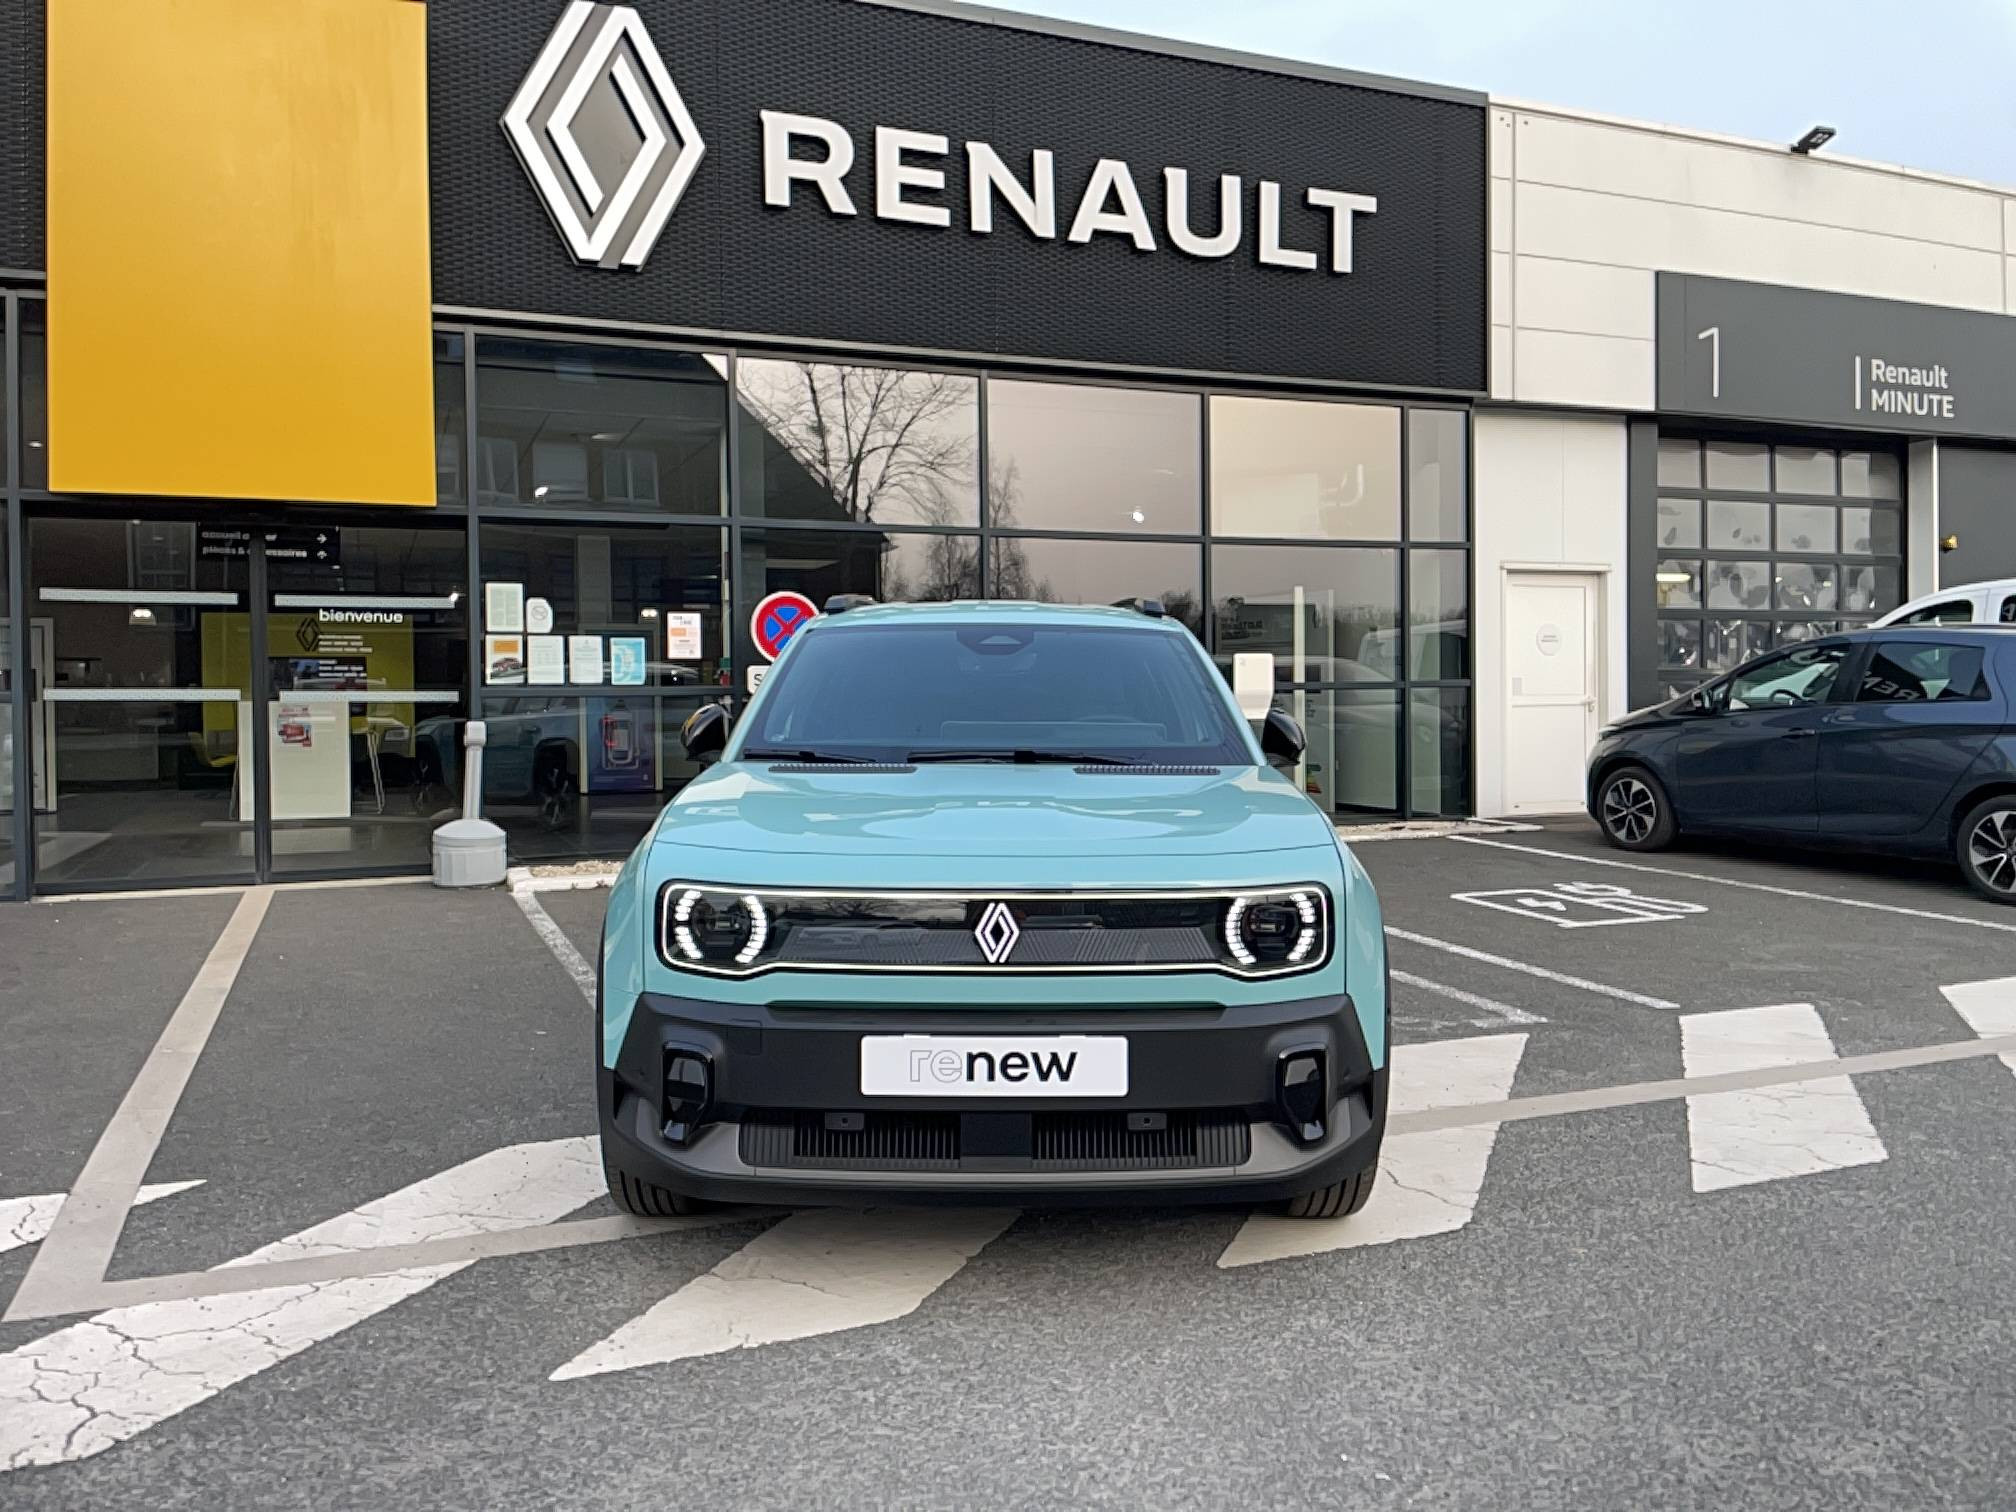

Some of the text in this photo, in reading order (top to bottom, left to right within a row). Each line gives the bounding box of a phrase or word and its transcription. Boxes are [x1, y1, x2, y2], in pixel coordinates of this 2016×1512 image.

[759, 109, 1378, 274] RENAULT
[1698, 327, 1720, 398] 1
[1870, 358, 1949, 390] Renault
[1870, 388, 1955, 418] MINUTE
[319, 608, 404, 624] bienvenue
[910, 1050, 1078, 1083] renew
